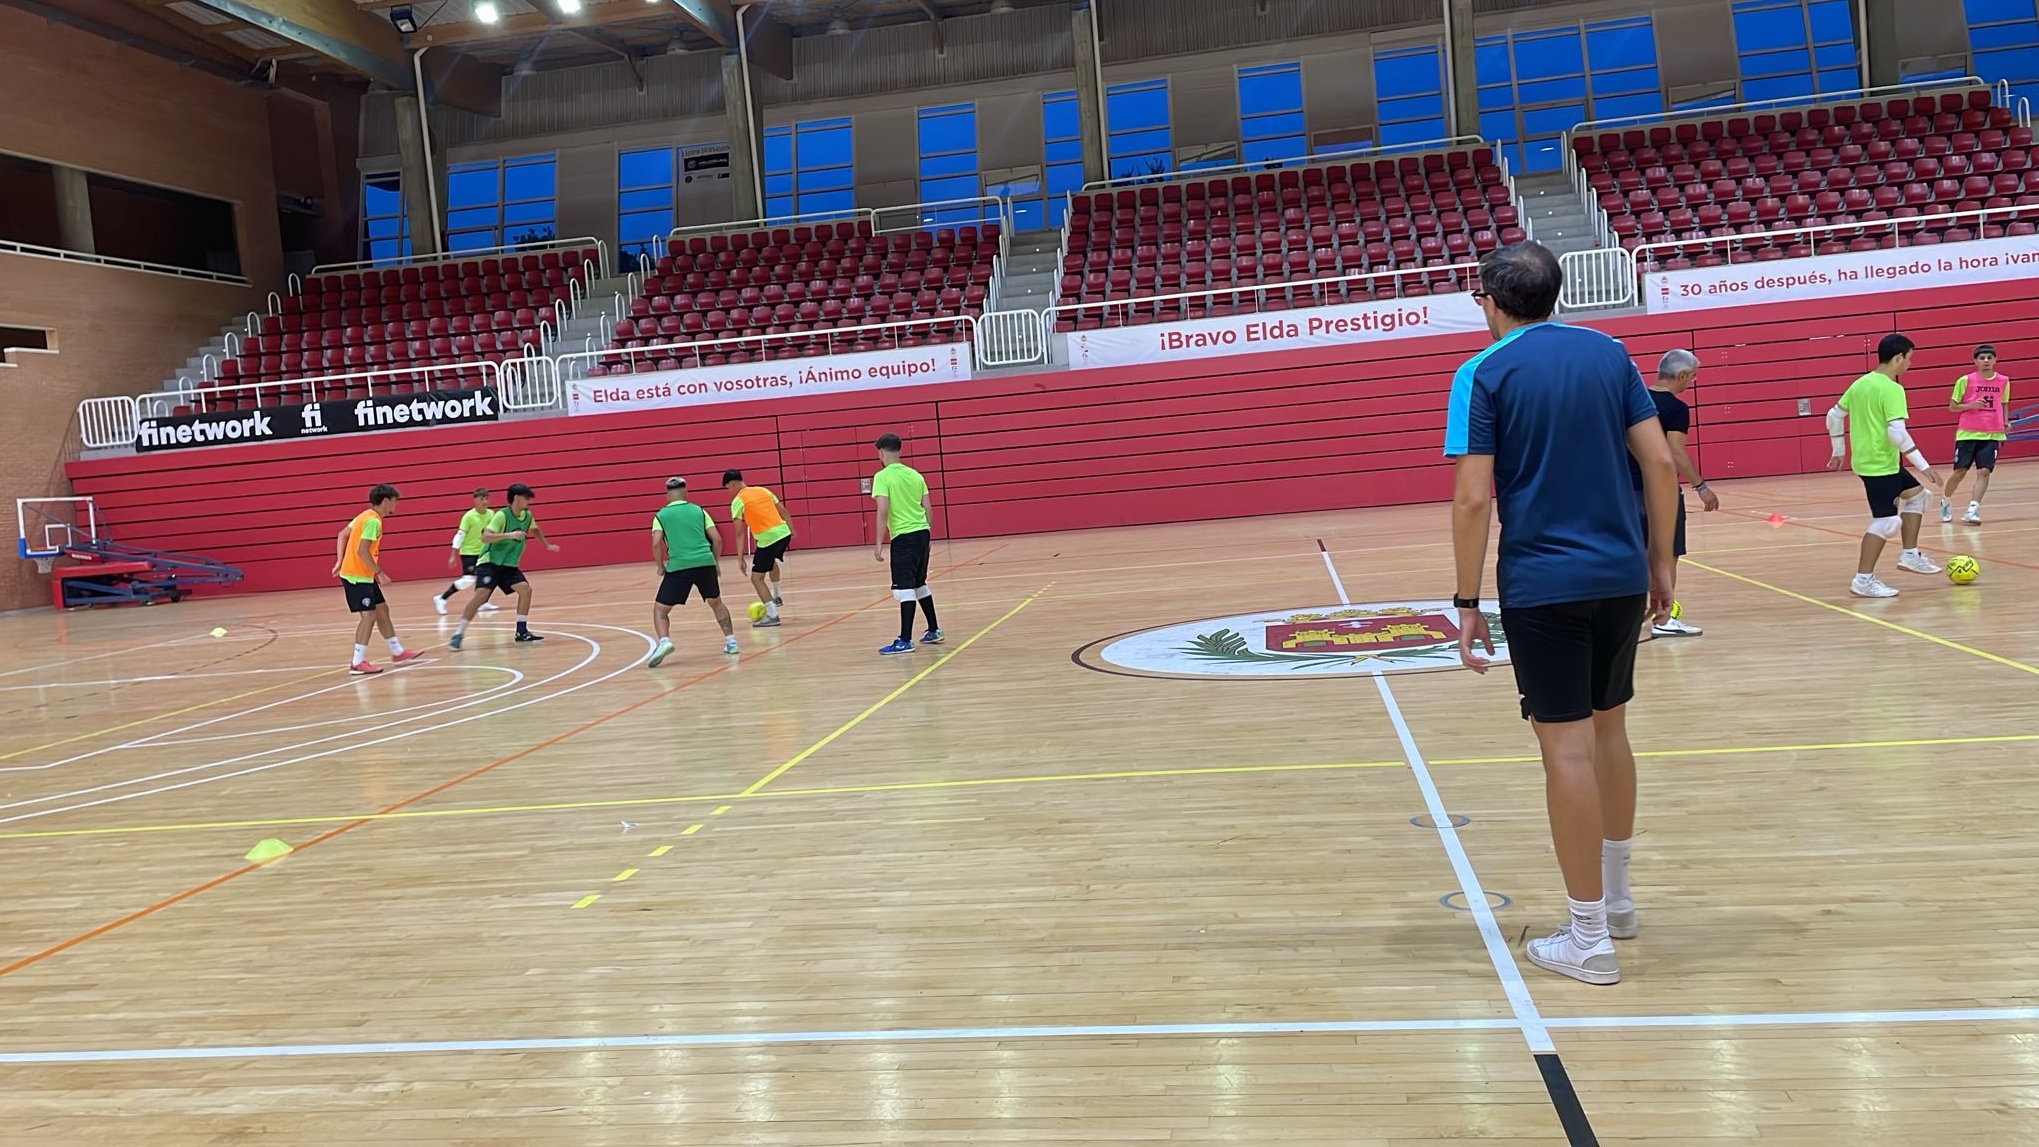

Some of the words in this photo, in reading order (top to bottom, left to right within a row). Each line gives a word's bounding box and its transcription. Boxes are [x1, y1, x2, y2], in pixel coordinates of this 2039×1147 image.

[1680, 284, 1702, 297] 30
[1708, 279, 1749, 295] años
[1754, 271, 1832, 291] después,
[1837, 268, 1859, 282] ha
[1864, 260, 1932, 279] llegado
[1937, 258, 1953, 272] la
[1958, 256, 1999, 270] hora
[1159, 329, 1237, 351] ¡Bravo
[1245, 319, 1299, 343] Elda
[1308, 306, 1429, 336] Prestigio!
[593, 387, 631, 404] Elda
[635, 382, 672, 400] está
[676, 382, 708, 396] con
[713, 375, 793, 393] vosotras,
[798, 365, 862, 385] ¡Ánimo
[867, 357, 936, 380] equipo!
[301, 402, 322, 428] fi
[354, 390, 494, 427] finetwork
[138, 410, 273, 448] finetwork
[300, 425, 328, 434] network
